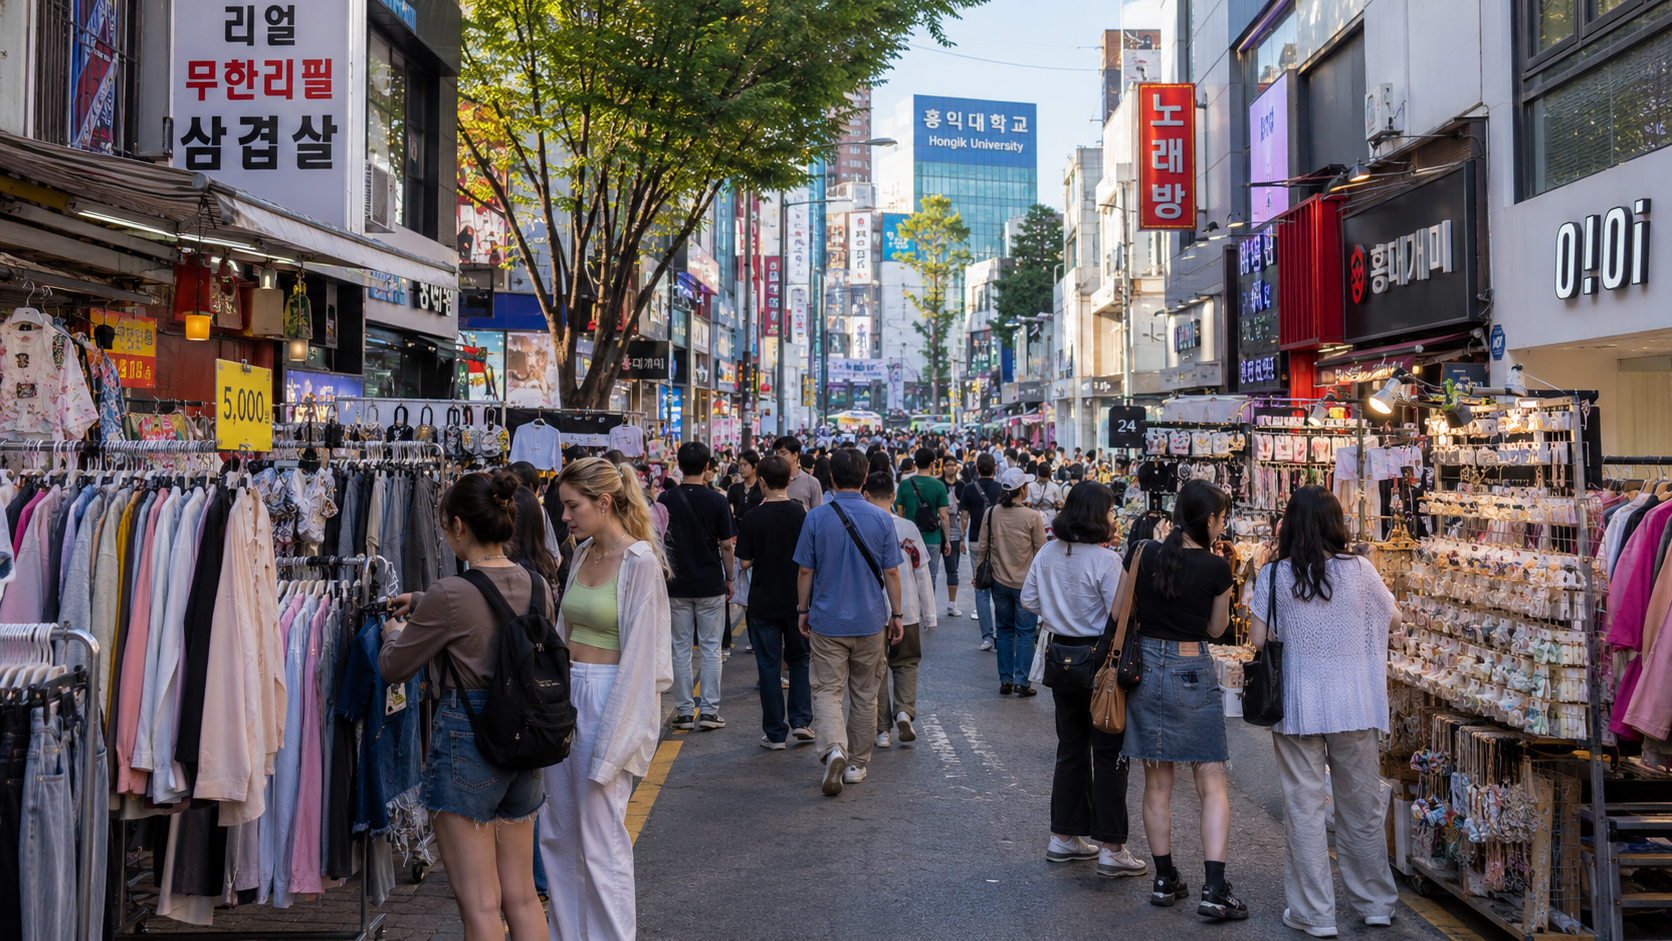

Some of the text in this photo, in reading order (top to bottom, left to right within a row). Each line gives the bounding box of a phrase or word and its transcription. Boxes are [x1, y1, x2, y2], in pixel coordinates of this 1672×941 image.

[225, 4, 296, 47] 리얼
[186, 58, 333, 101] 무한리필
[180, 114, 338, 171] 삼겹살
[923, 109, 1029, 134] 홍익대학교
[929, 135, 1024, 154] Hongik University
[1150, 94, 1186, 219] 노래방
[1370, 219, 1452, 294] 홍대개미
[1117, 418, 1137, 434] 24
